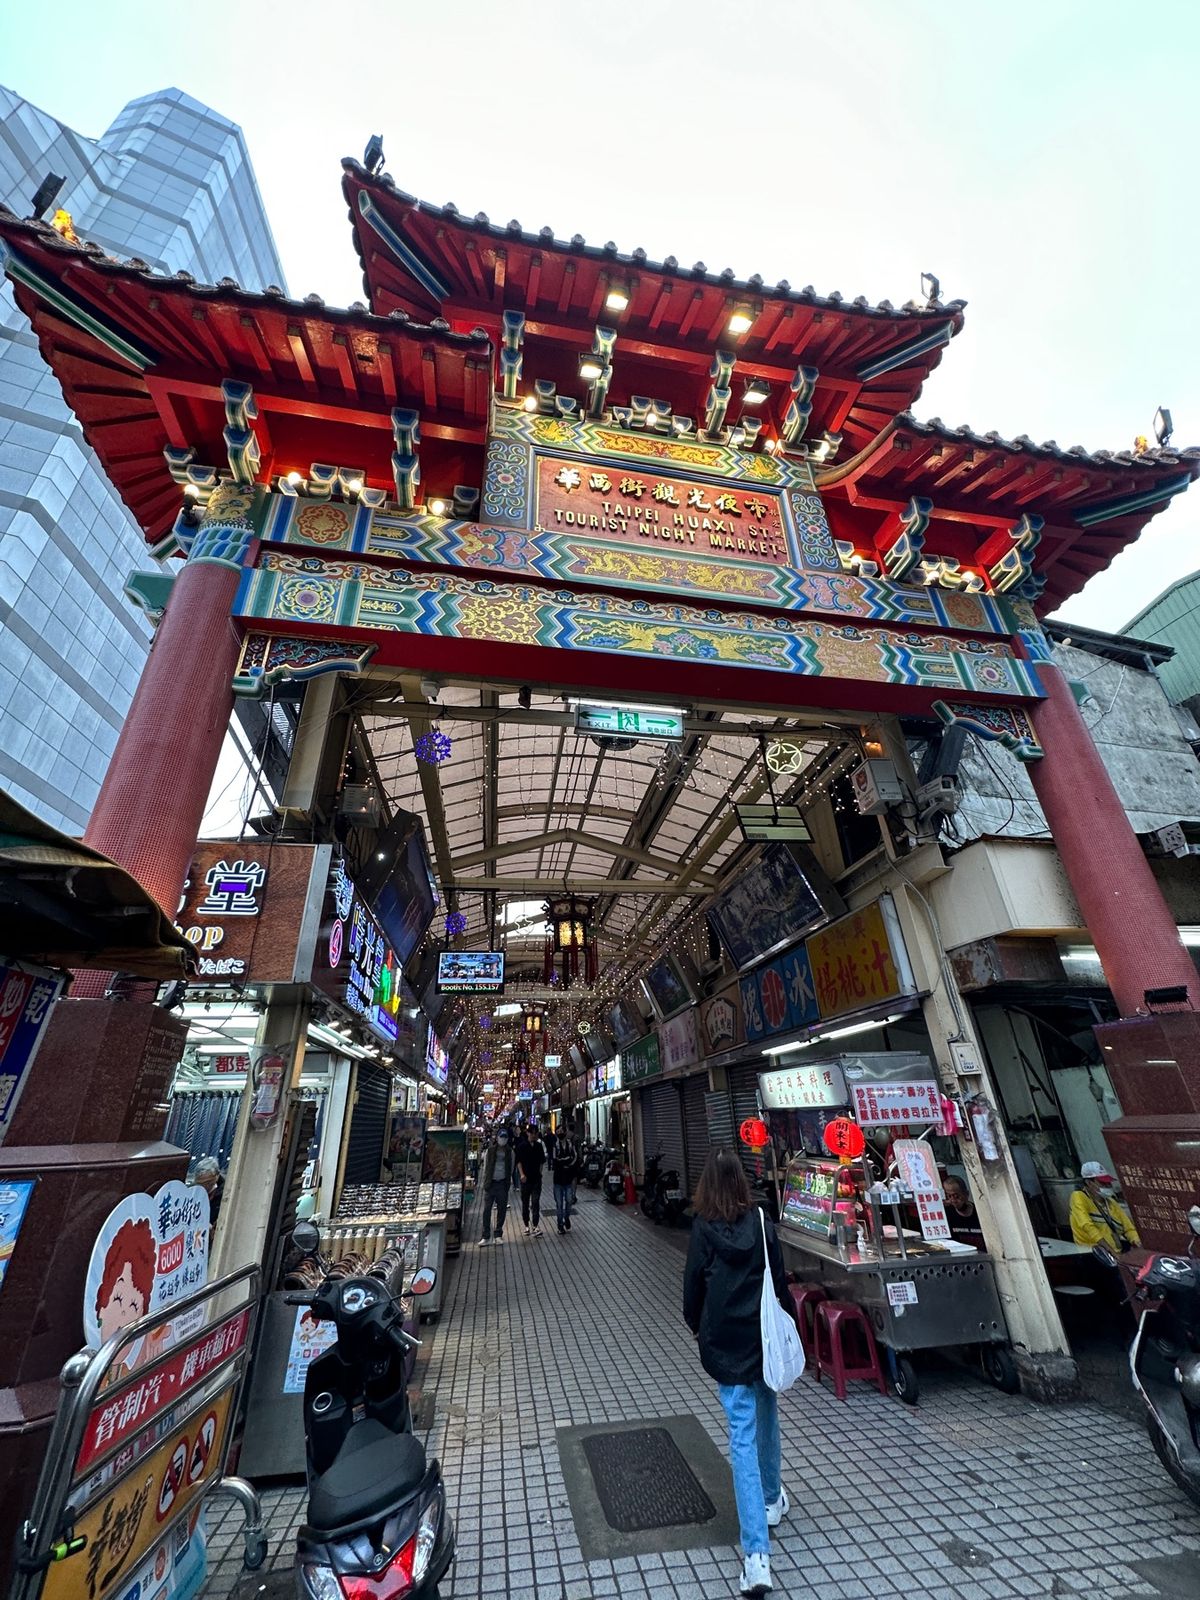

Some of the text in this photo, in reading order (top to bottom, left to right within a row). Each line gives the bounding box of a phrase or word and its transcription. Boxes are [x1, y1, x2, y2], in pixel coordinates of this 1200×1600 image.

[554, 466, 768, 520] 華西街觀光夜市
[554, 509, 778, 555] TOURIST NIGHT MARKET
[602, 501, 659, 521] TAIPEI
[673, 513, 734, 533] HUAXI
[748, 525, 773, 539] ST.
[177, 860, 266, 915] 堂
[199, 957, 245, 975] たばこ
[160, 1242, 182, 1271] 6000
